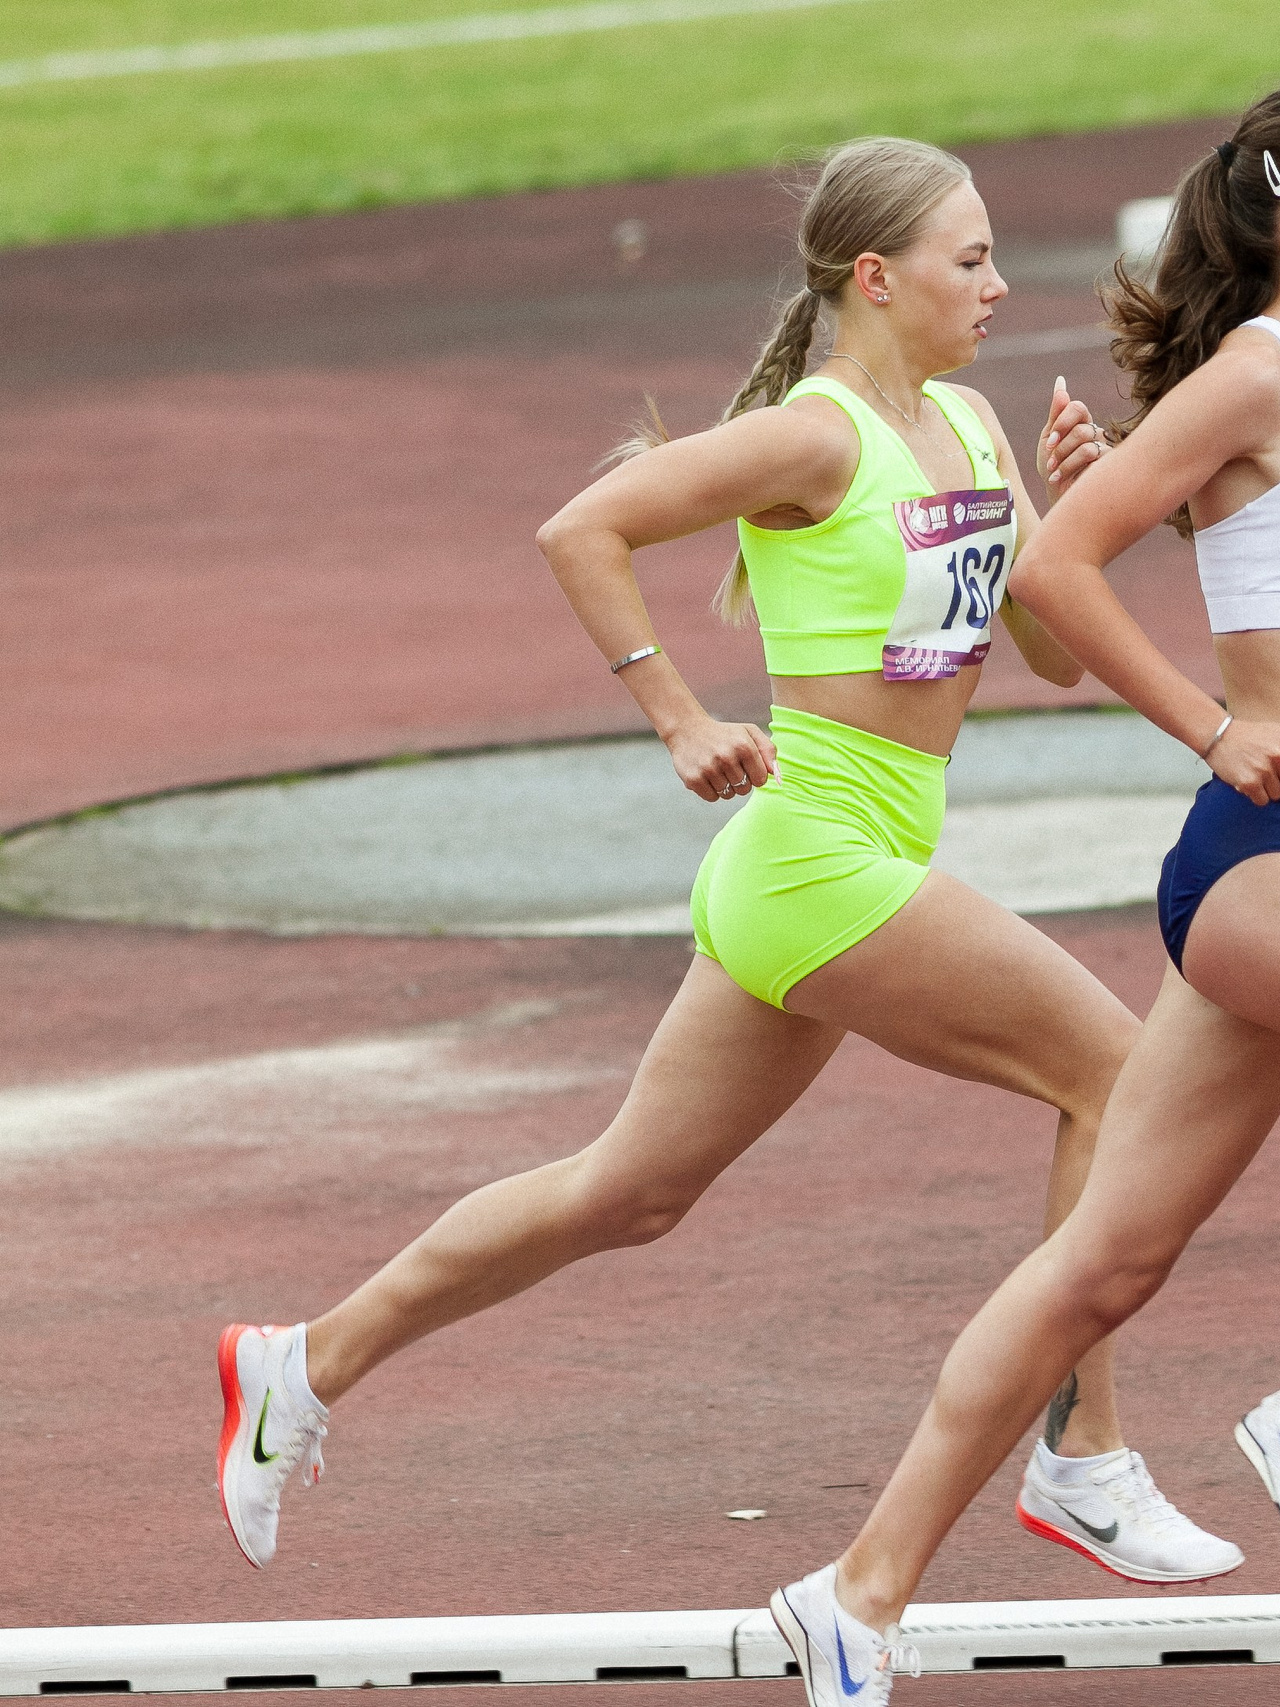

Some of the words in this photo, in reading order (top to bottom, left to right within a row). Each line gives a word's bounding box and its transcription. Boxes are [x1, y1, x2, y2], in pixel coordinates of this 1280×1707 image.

[967, 499, 1008, 509] БАЛТИЙСКИЙ
[966, 508, 1007, 522] ЛИЗИНГ
[941, 543, 1005, 630] 162
[895, 656, 950, 665] МЕМОРИАЛ
